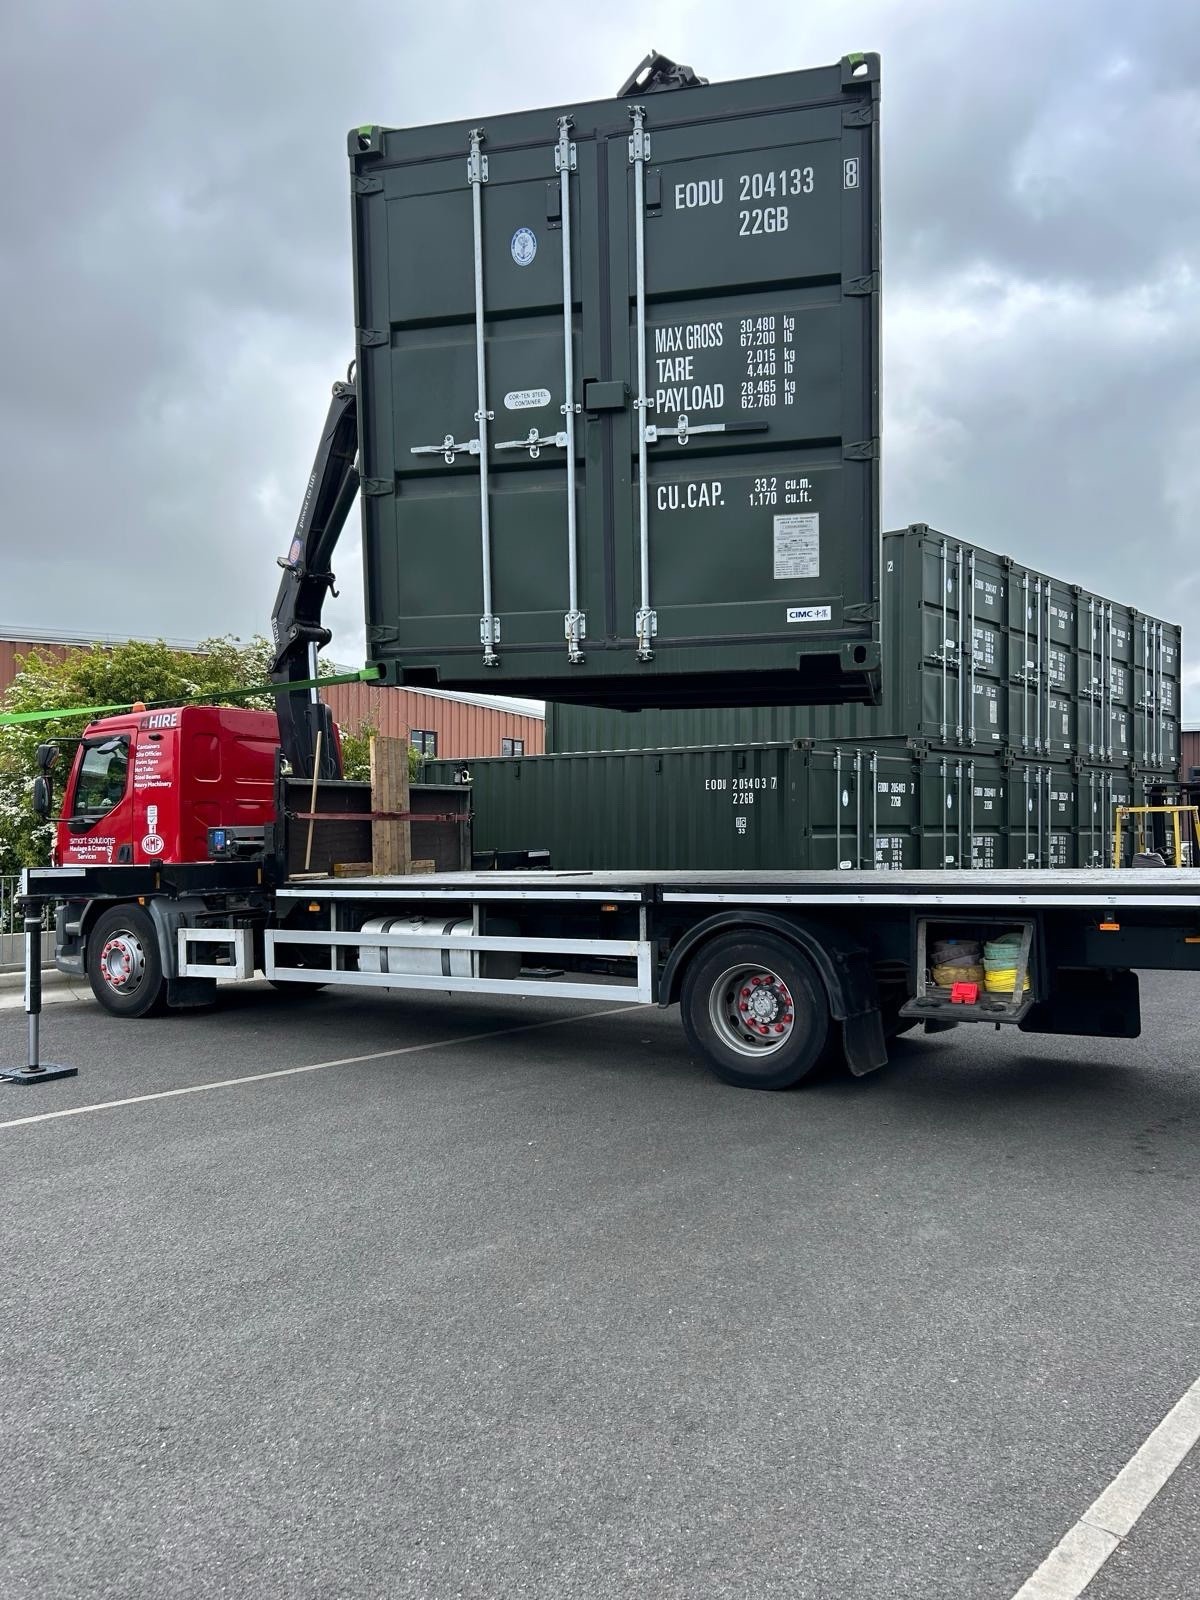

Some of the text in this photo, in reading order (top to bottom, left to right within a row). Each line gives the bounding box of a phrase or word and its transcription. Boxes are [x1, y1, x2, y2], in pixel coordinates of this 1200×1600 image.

[675, 157, 860, 210] EODU 204133 8
[739, 206, 789, 236] 22GB
[783, 315, 795, 330] kg
[655, 322, 723, 353] MAX GROSS
[783, 330, 793, 343] lb
[784, 347, 796, 362] kg
[655, 356, 694, 383] TARE
[784, 362, 793, 374] lb
[784, 378, 796, 393] kg
[514, 399, 541, 407] CONTAINER
[656, 383, 724, 414] PAYLOAD
[784, 393, 794, 405] lb
[754, 477, 777, 492] 33.2
[657, 481, 725, 511] CU.CAP.
[148, 780, 172, 788] Machinery
[705, 779, 726, 790] EODU
[732, 778, 766, 789] 205403
[732, 793, 754, 804] 22GB
[88, 837, 115, 845] solutions
[70, 845, 87, 853] Haulage
